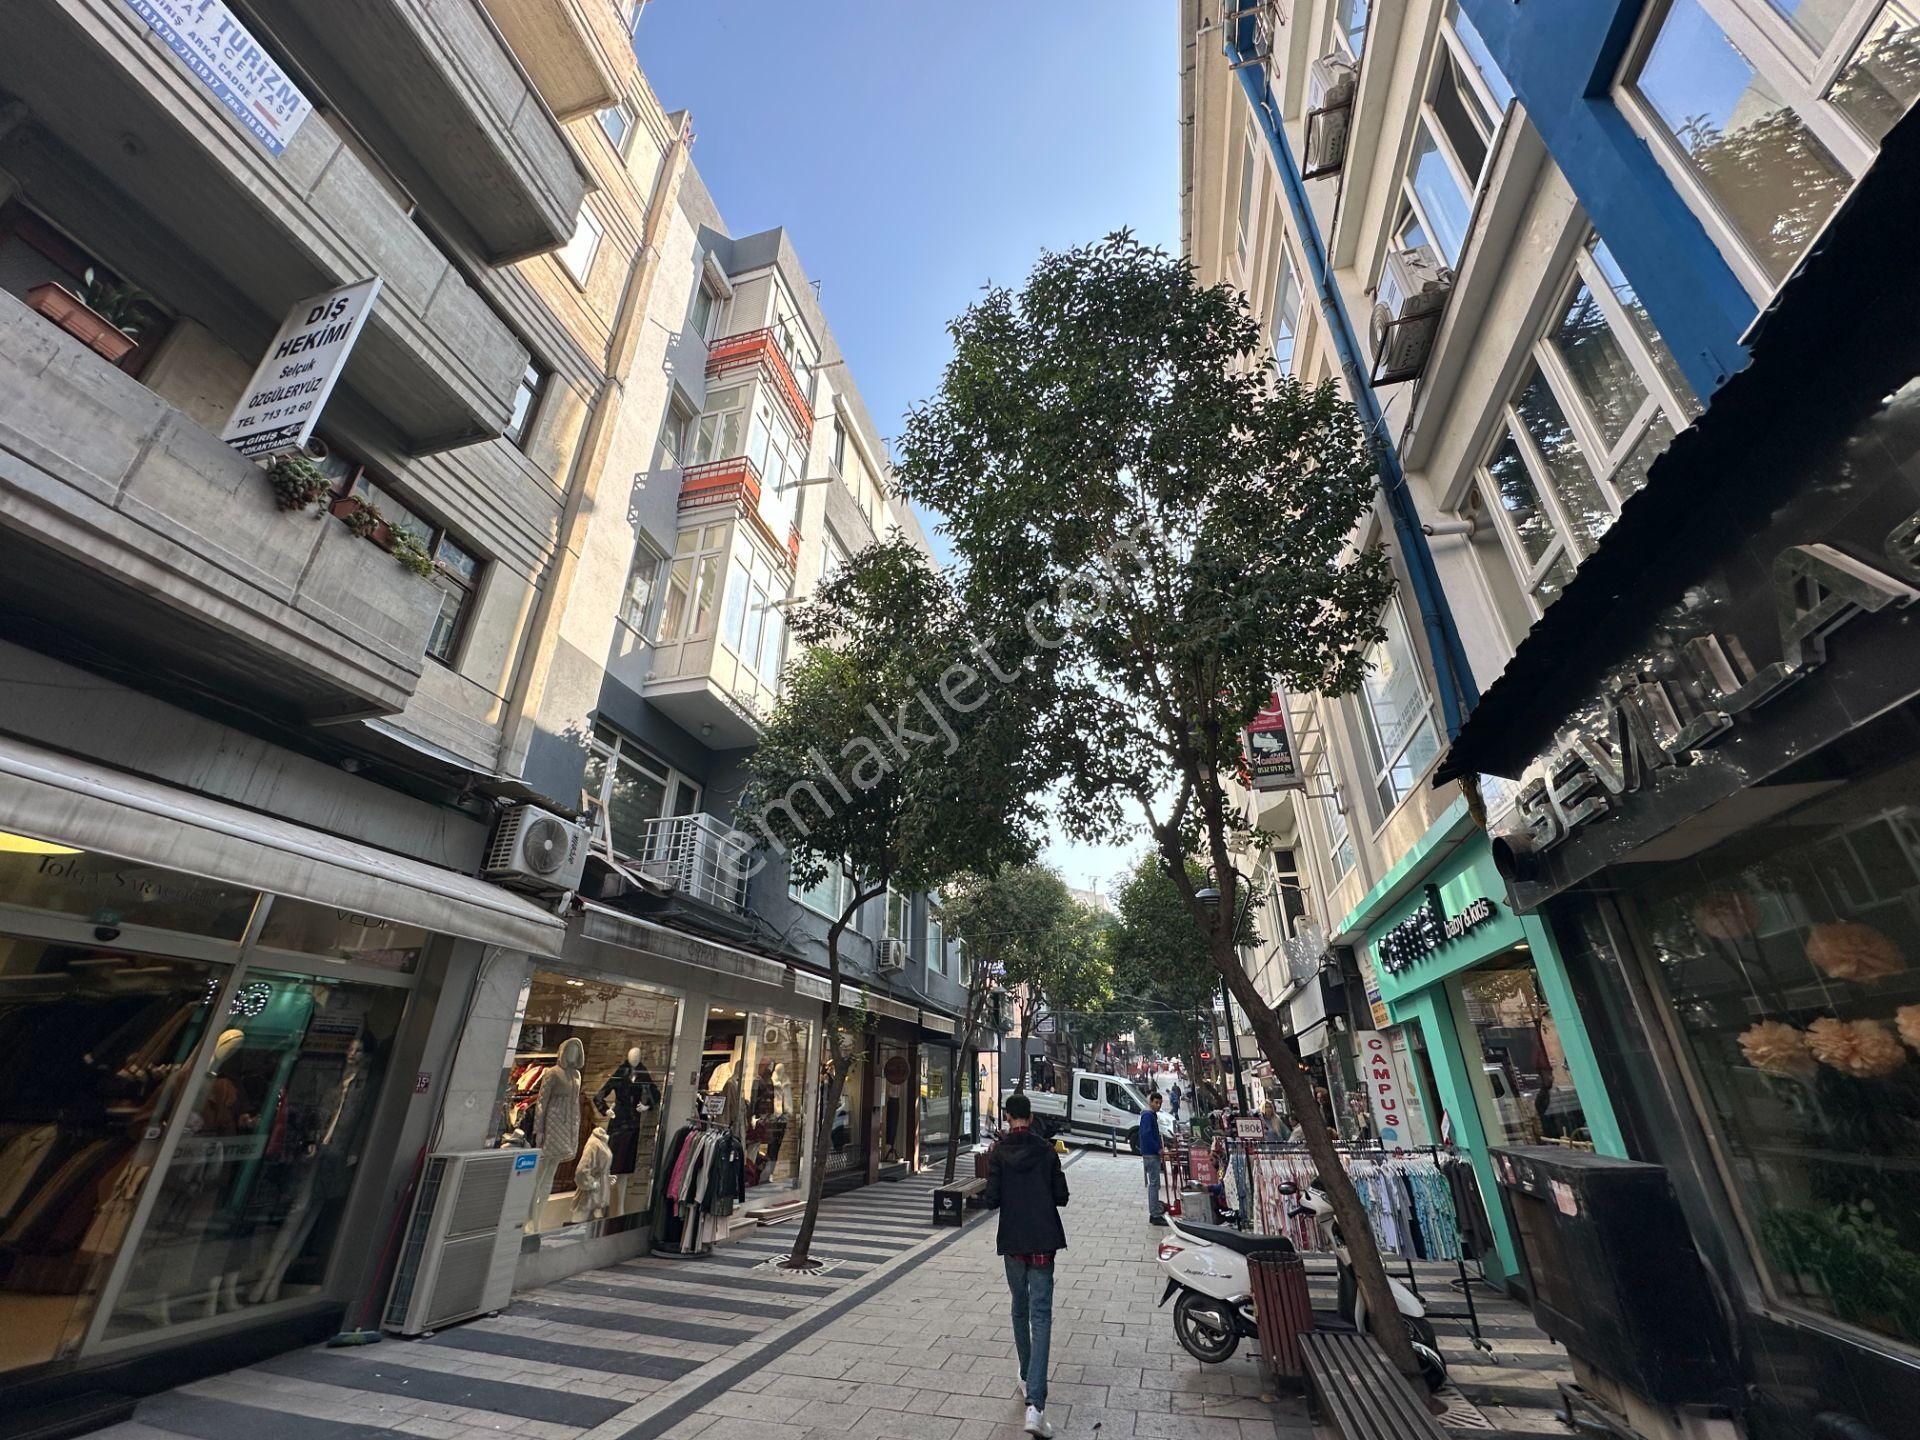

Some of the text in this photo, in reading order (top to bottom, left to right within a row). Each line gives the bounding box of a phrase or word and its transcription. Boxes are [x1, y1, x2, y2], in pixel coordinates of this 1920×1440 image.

[187, 31, 216, 63] ARKA
[218, 62, 252, 98] CADDE
[305, 297, 349, 326] DİŞ
[274, 317, 354, 360] HEKİMİ
[279, 358, 316, 379] Selçuk
[248, 377, 323, 409] ÖZGÜLERYÜZ
[236, 417, 255, 429] TEL
[261, 410, 280, 423] 713
[283, 406, 295, 416] 12
[1367, 1039, 1400, 1126] CAMPUS
